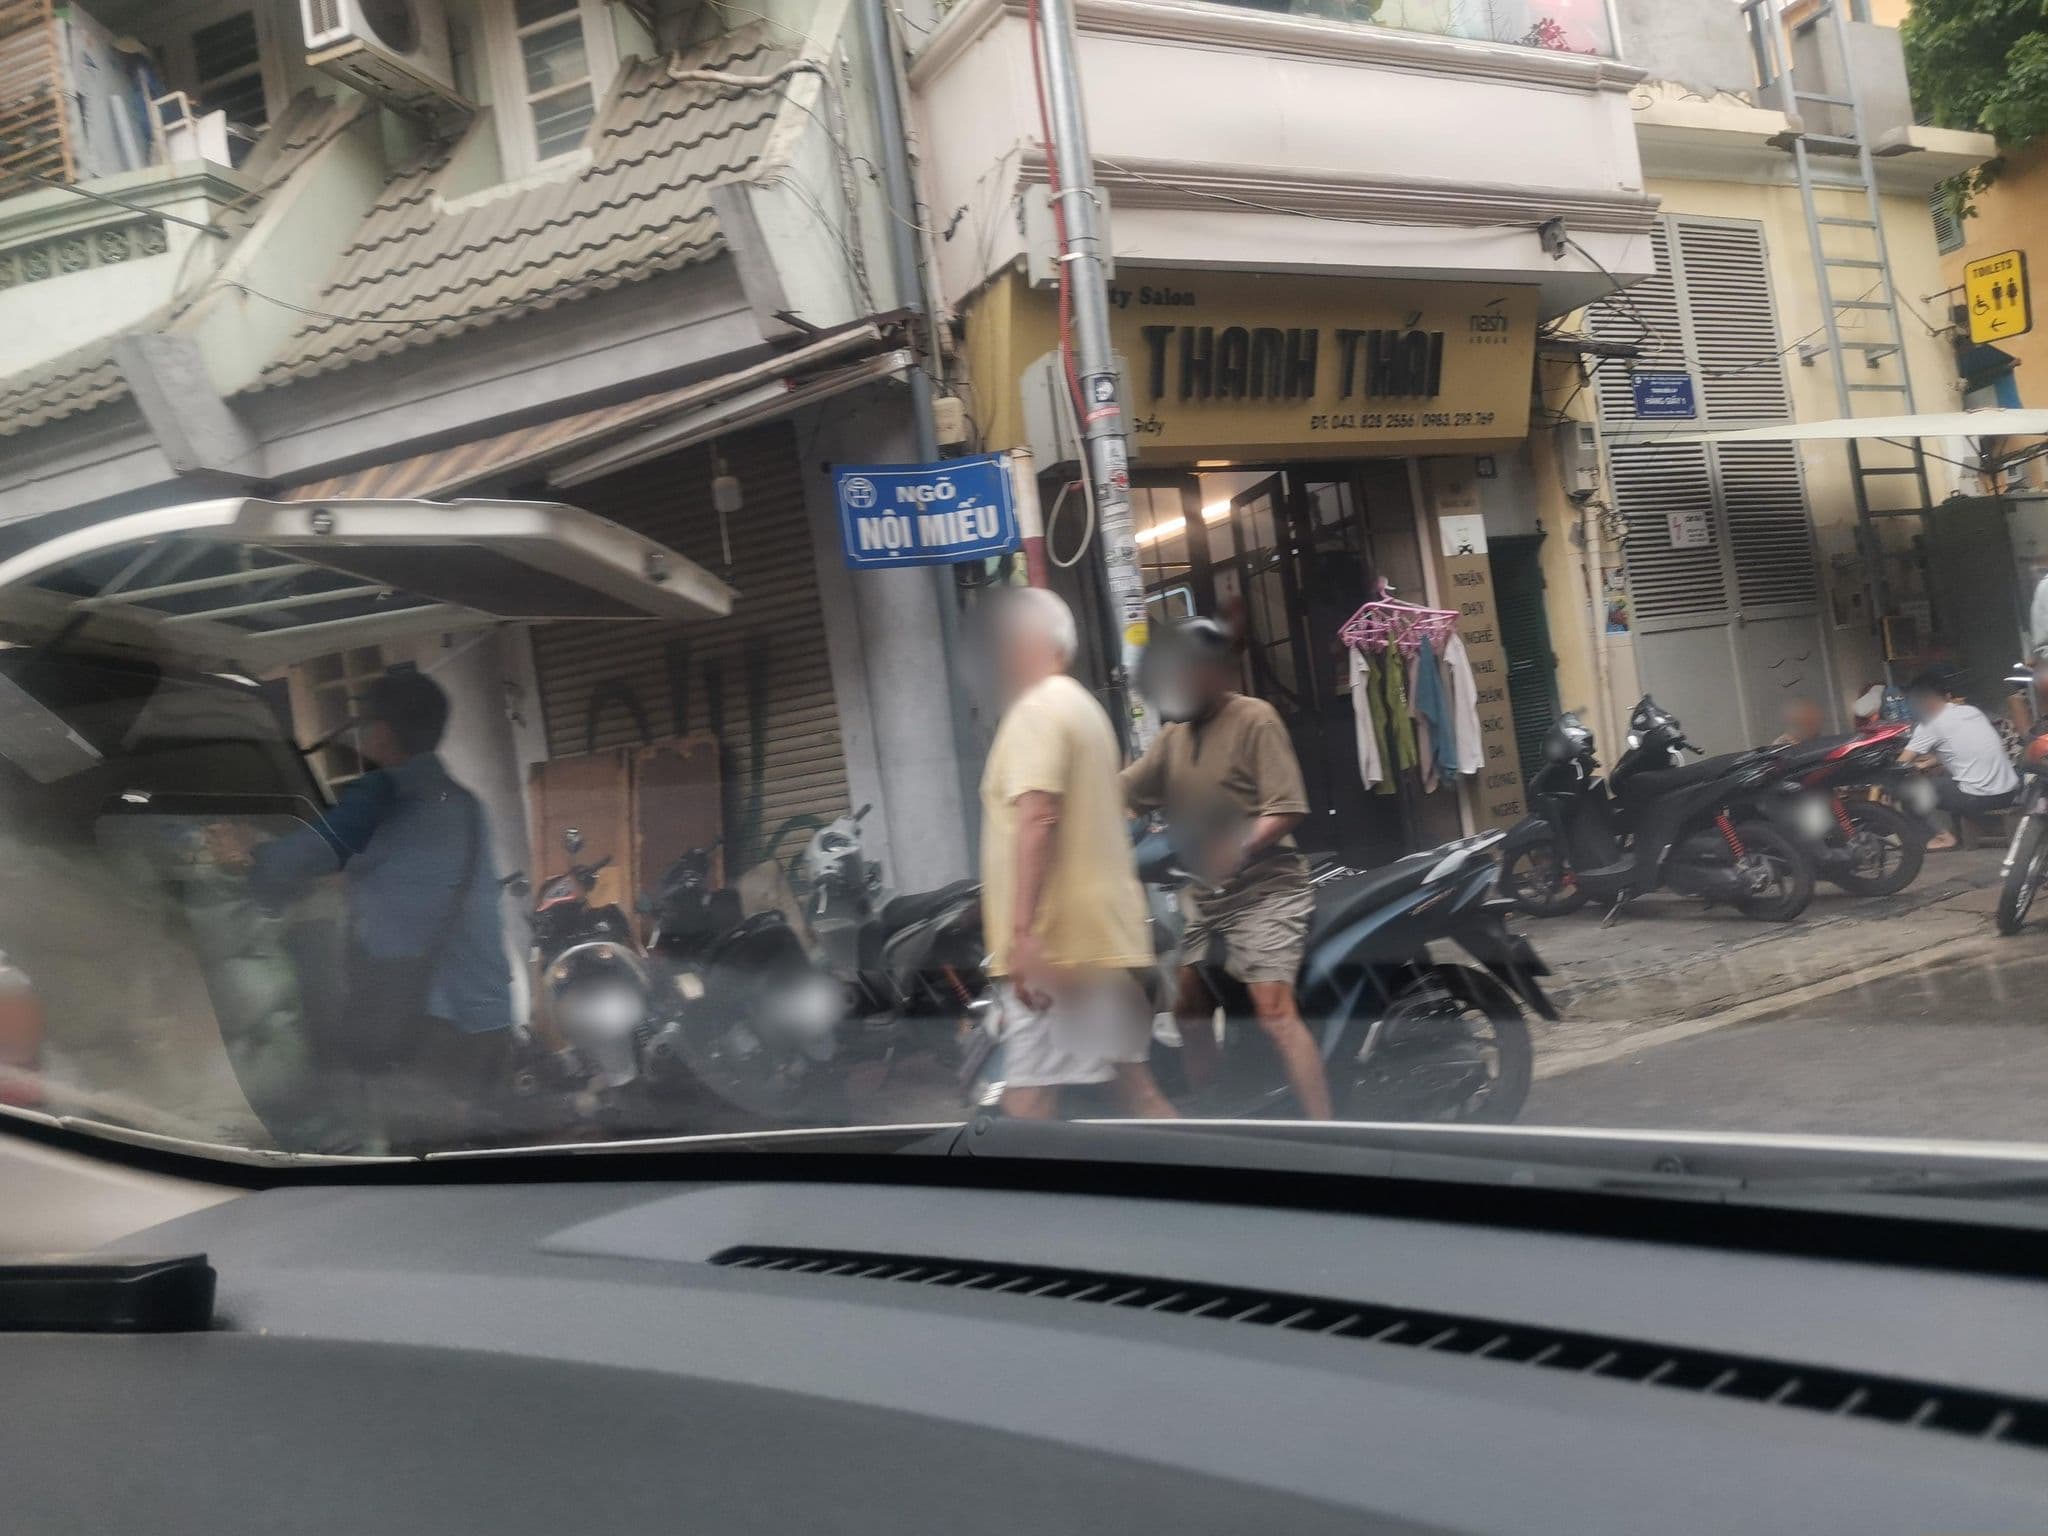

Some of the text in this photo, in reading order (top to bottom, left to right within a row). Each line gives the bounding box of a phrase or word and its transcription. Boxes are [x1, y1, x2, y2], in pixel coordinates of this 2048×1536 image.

[1973, 259, 2012, 278] TOILETS
[1140, 286, 1196, 305] Salon
[1141, 312, 1445, 398] THANH THÁI
[896, 476, 957, 504] NGÕ
[857, 497, 999, 557] NỘI MIẾU
